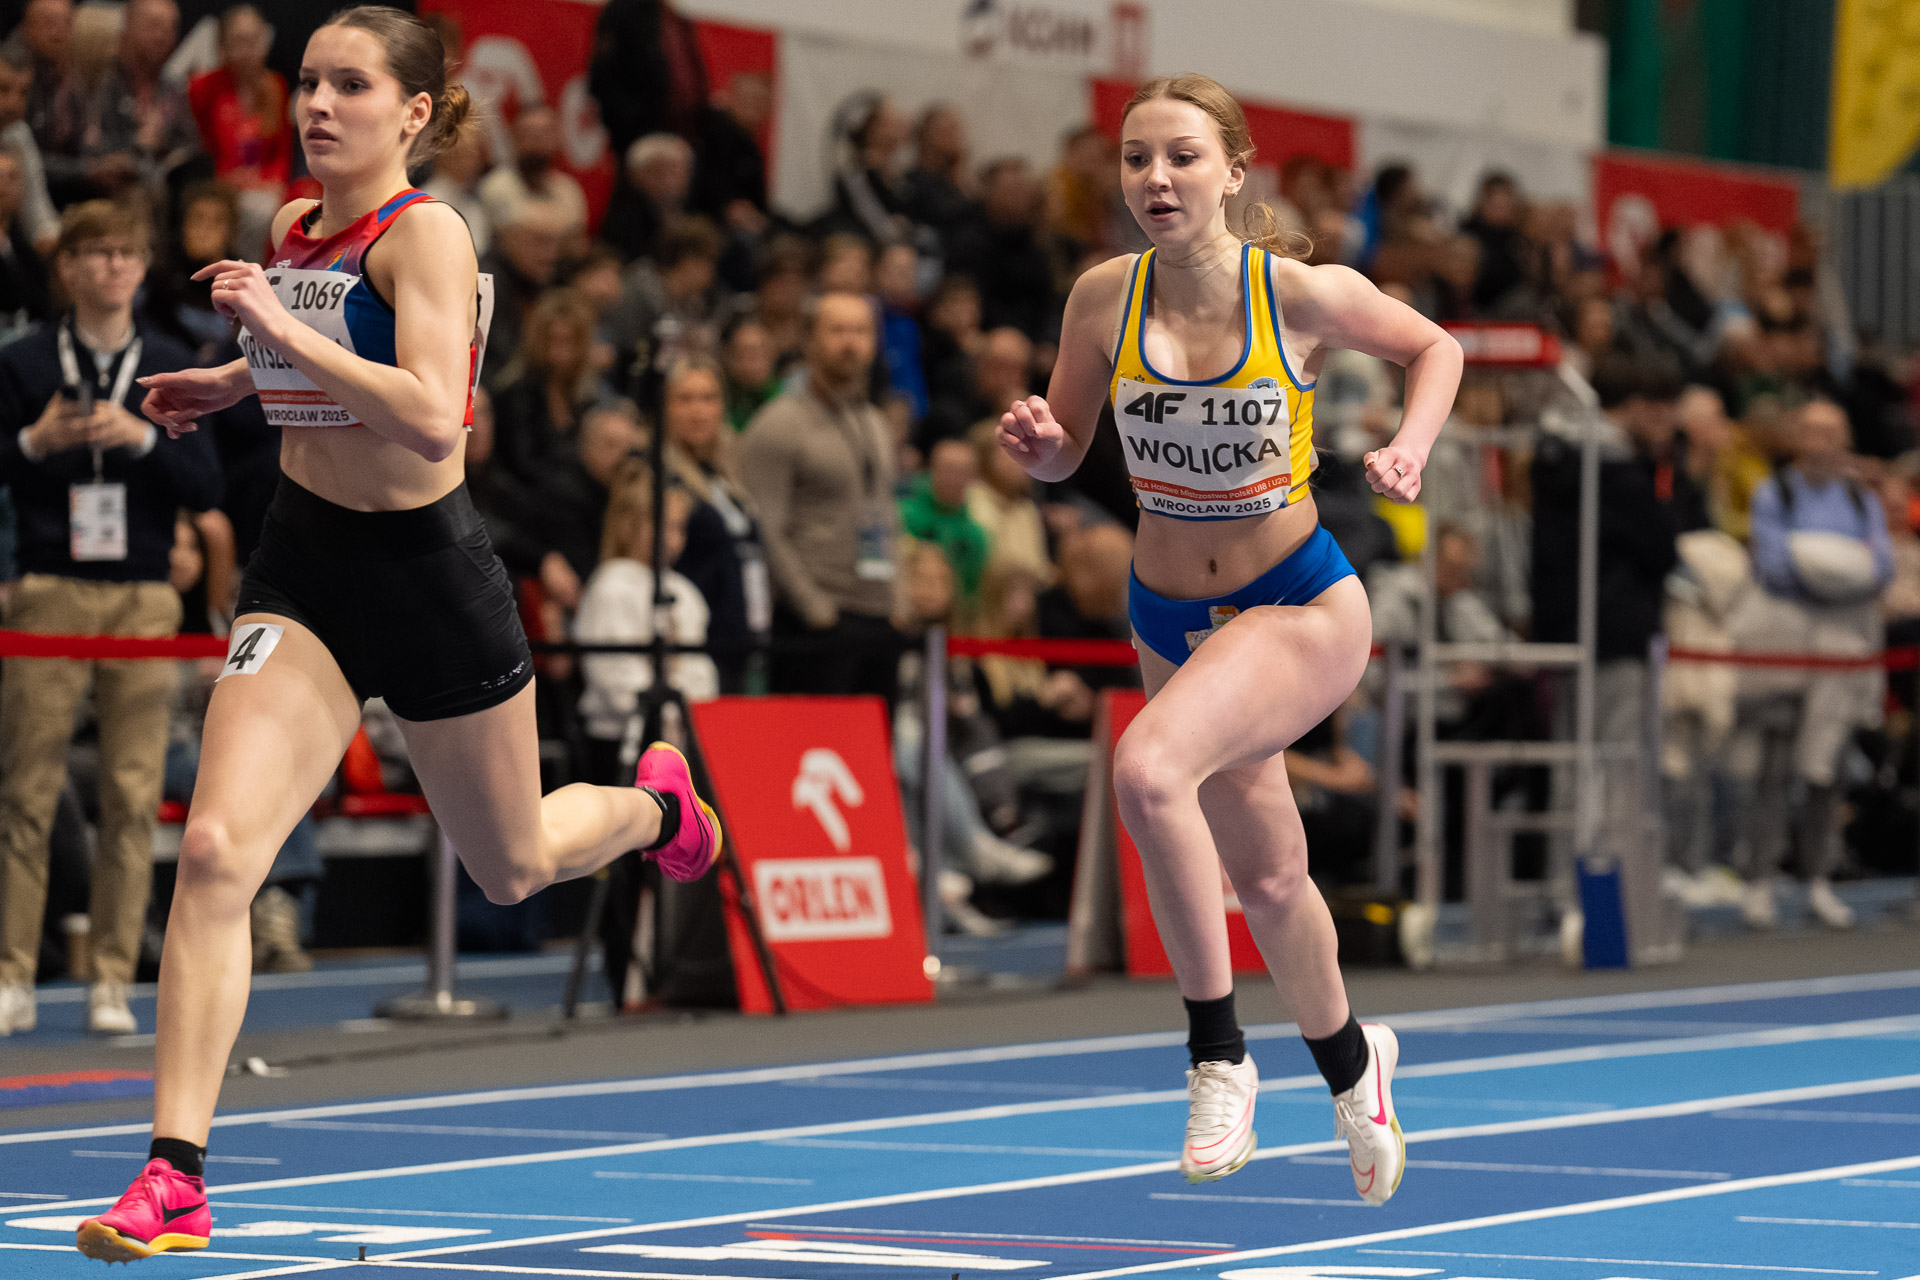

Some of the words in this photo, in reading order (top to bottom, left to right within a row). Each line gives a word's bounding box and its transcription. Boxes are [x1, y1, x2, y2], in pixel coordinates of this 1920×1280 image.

[291, 281, 346, 310] 1069
[321, 410, 350, 422] 2025
[1124, 391, 1187, 424] 4F
[1201, 397, 1282, 426] 1107
[1127, 435, 1282, 475] WOLICKA
[1150, 482, 1179, 494] Halowe
[1180, 488, 1228, 500] Mistrzostwa
[1229, 487, 1254, 499] Polski
[1254, 482, 1268, 494] U18
[1271, 476, 1288, 486] U20
[1152, 497, 1231, 514] WROCŁAW
[1235, 497, 1271, 513] 2025
[228, 627, 267, 671] 4
